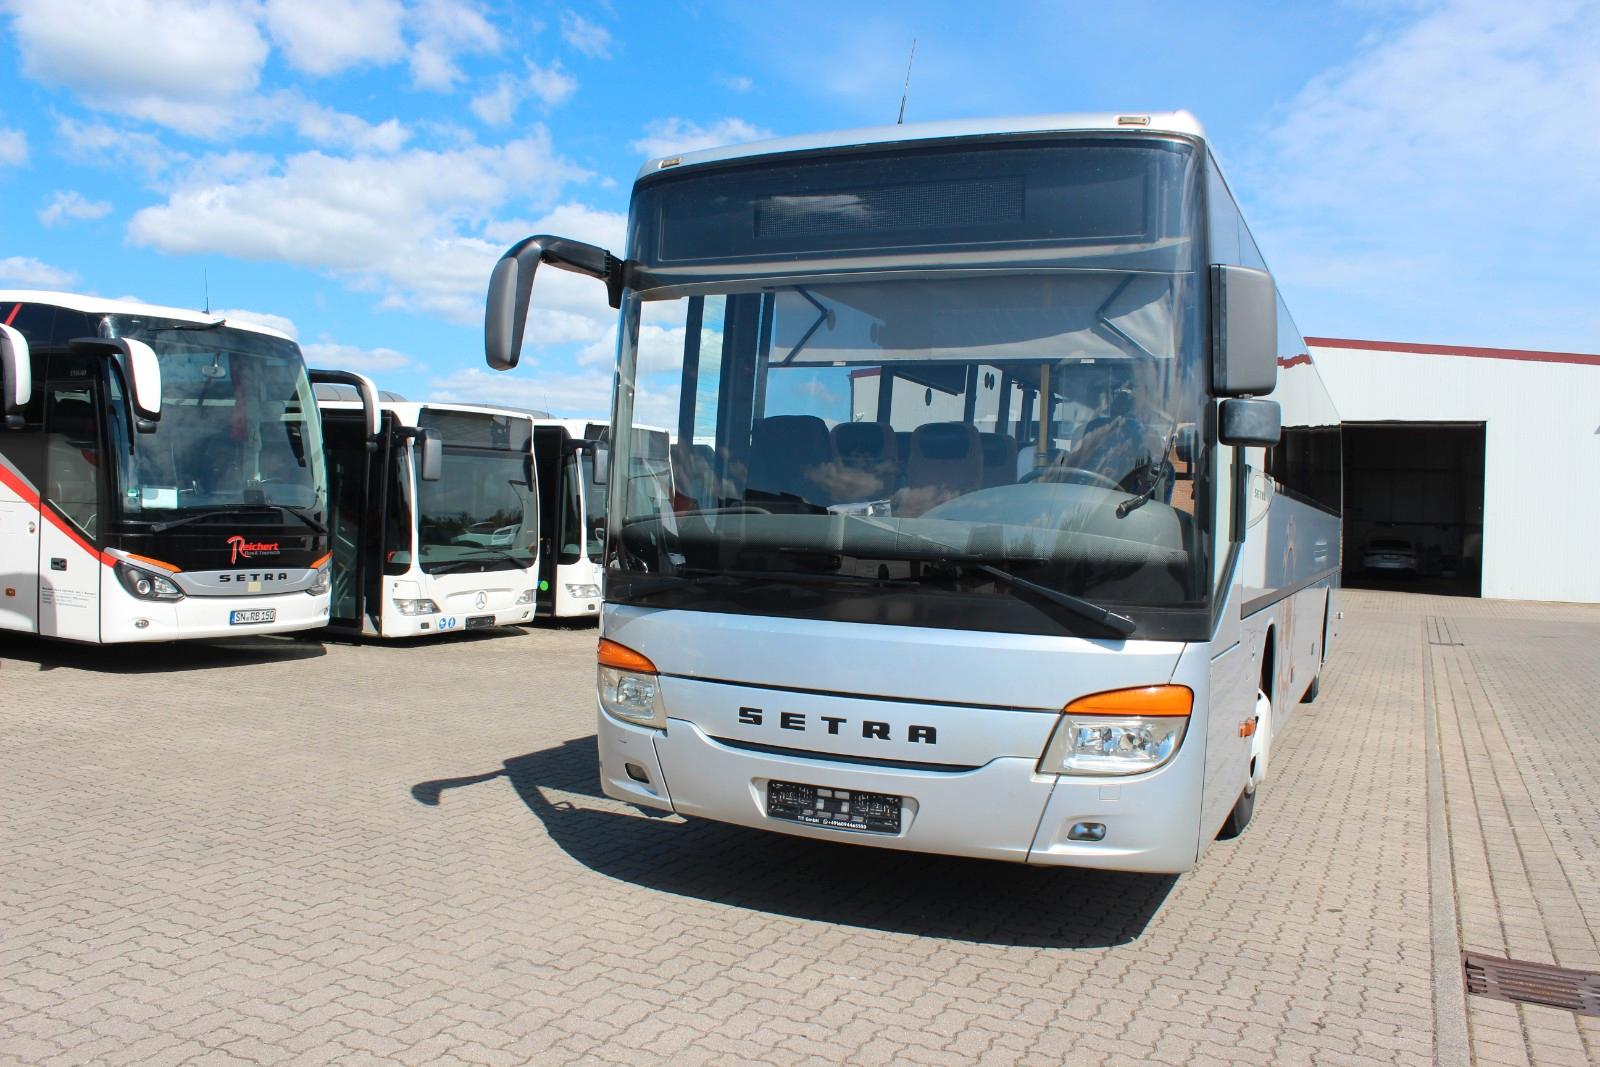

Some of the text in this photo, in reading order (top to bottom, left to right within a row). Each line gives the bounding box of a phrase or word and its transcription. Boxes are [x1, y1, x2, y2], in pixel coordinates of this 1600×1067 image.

[226, 535, 279, 565] Reichert
[219, 573, 288, 582] SETRA
[738, 706, 937, 745] SETRA
